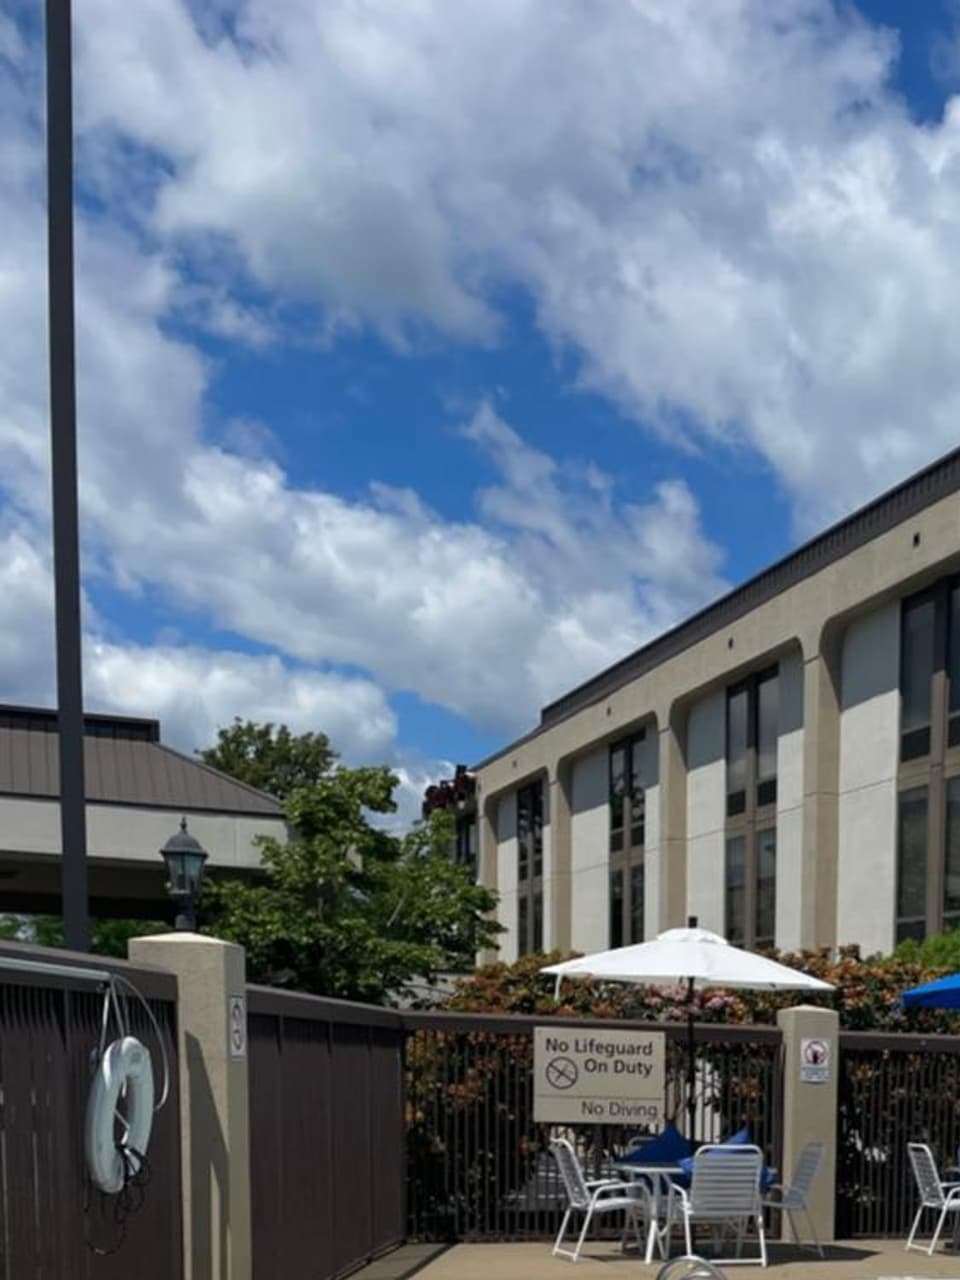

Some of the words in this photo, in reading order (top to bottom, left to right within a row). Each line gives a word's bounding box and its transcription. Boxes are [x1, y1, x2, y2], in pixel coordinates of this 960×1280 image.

[545, 1038, 569, 1053] No
[575, 1039, 653, 1057] Lifeguard
[584, 1058, 608, 1073] On
[614, 1060, 653, 1077] Duty
[581, 1101, 604, 1116] No
[609, 1102, 657, 1119] Diving
